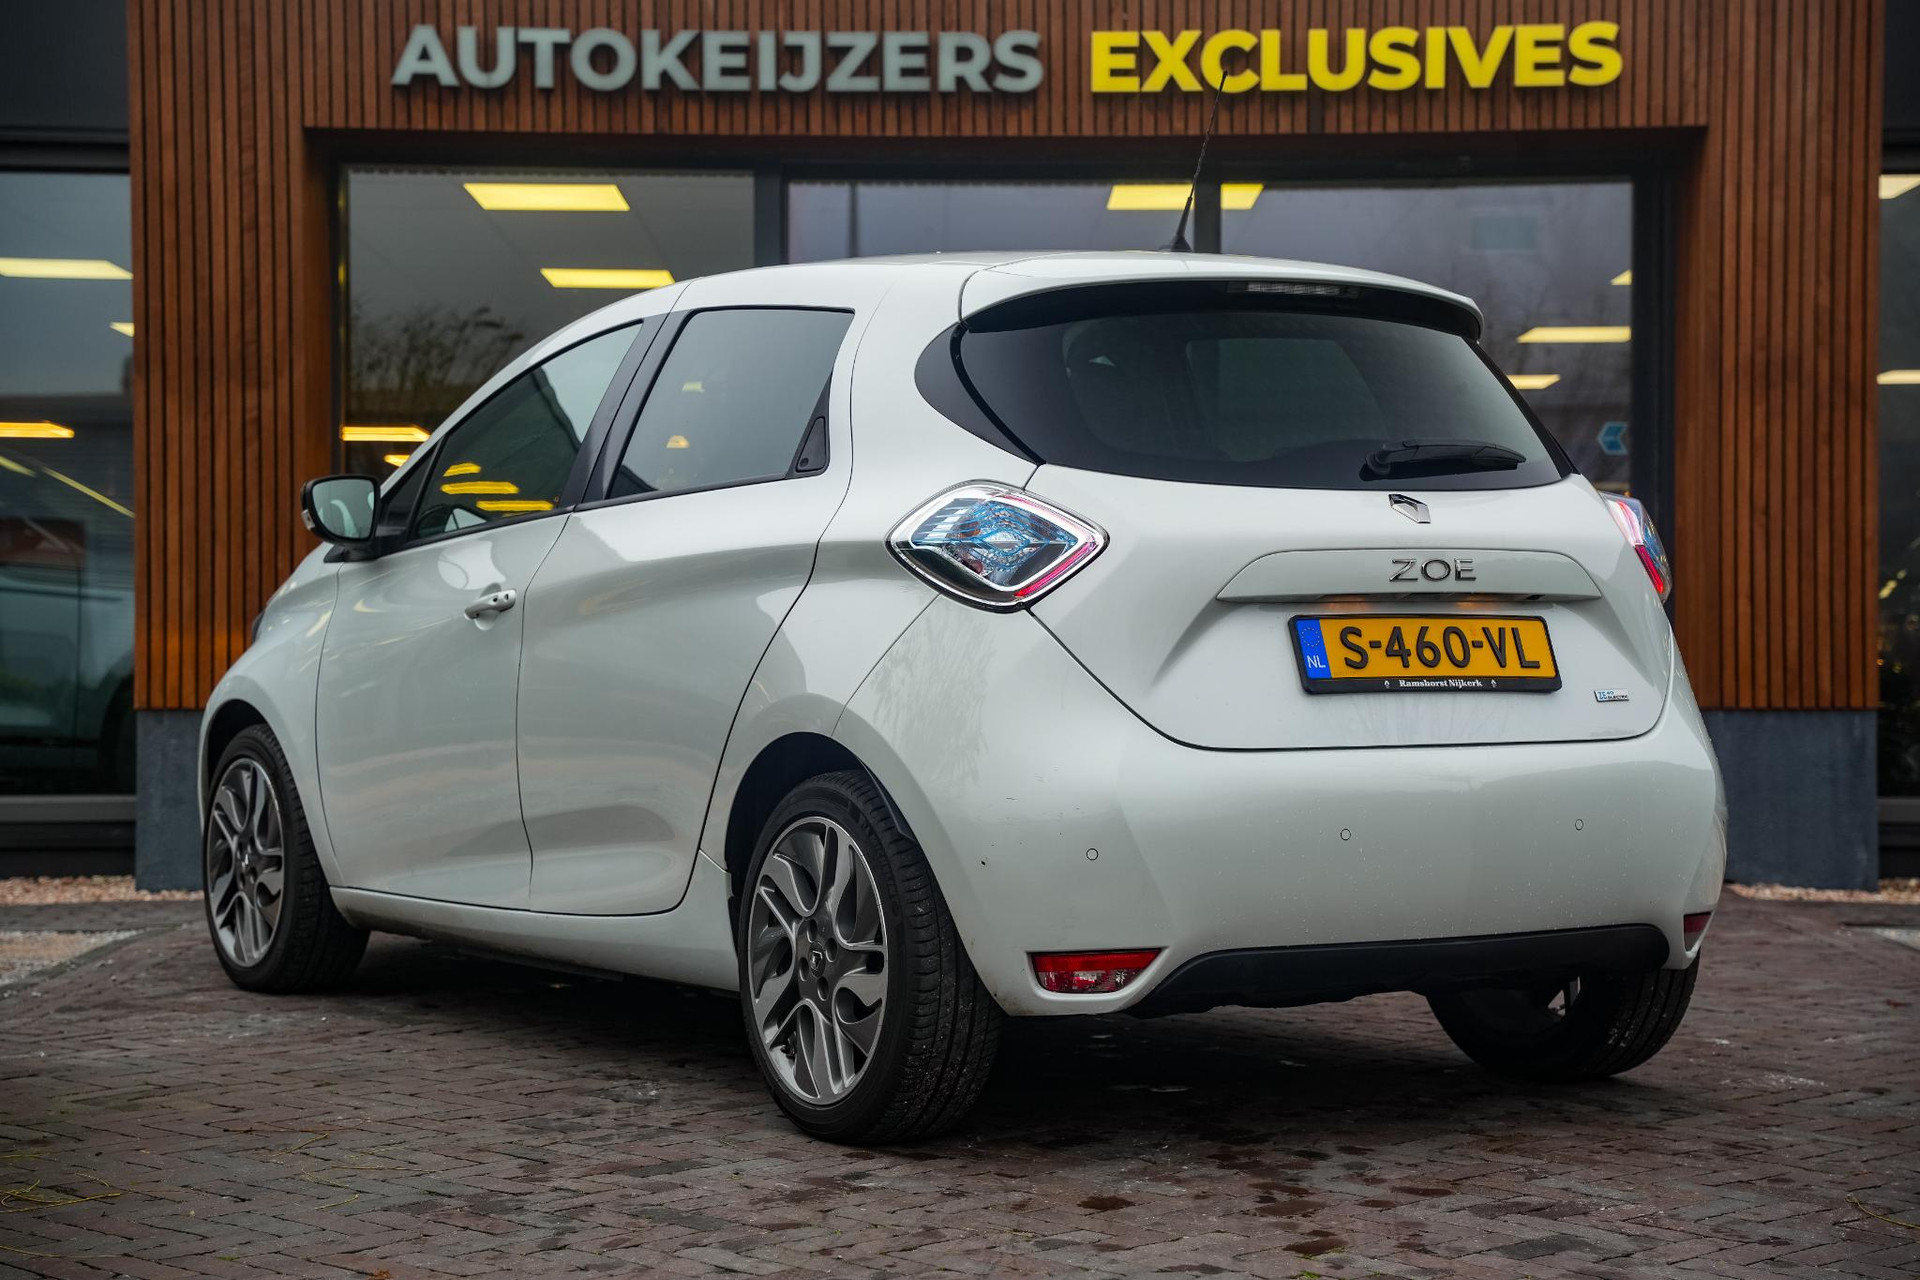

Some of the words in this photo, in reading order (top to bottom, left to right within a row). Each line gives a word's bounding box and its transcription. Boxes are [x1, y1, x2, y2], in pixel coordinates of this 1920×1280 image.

[391, 24, 1044, 94] AUTOKEIJZERS
[1090, 20, 1624, 94] EXCLUSIVES
[1389, 558, 1477, 582] ZOE
[1339, 625, 1541, 670] S-460-VL
[1306, 655, 1326, 669] NL
[1399, 679, 1448, 688] Ramshorst
[1448, 679, 1483, 689] Nijkerk
